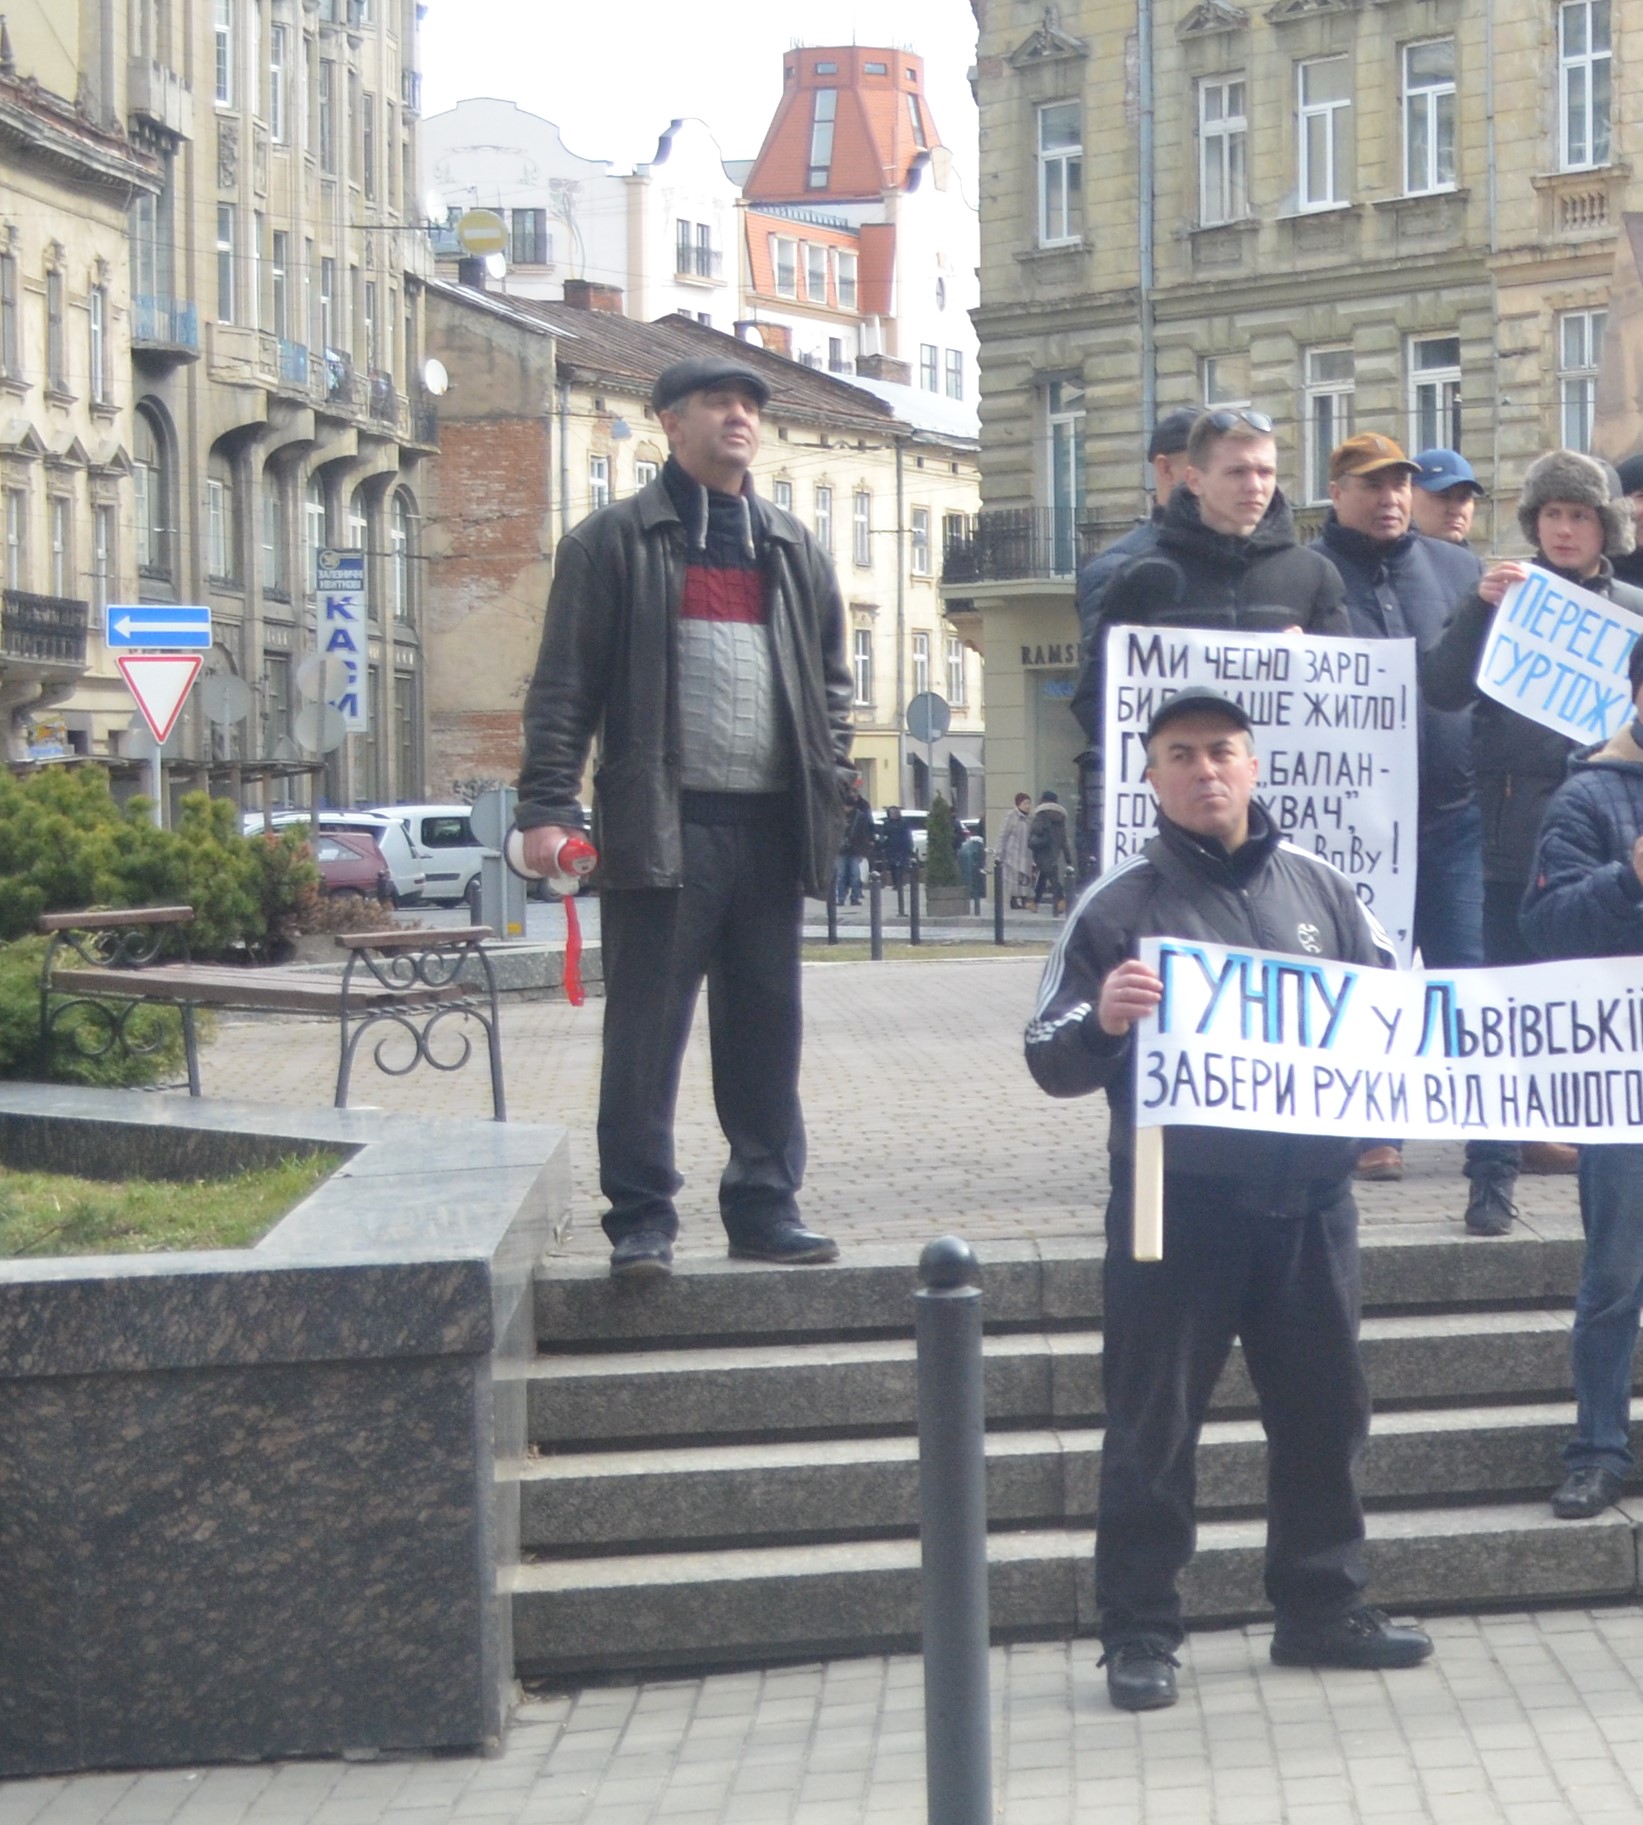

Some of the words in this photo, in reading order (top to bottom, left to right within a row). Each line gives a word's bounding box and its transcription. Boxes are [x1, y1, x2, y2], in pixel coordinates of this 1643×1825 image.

[1021, 644, 1080, 665] RAMS
[1204, 646, 1290, 682] ЧЕСНО
[1303, 685, 1407, 730] ЖИТЛО!
[1158, 943, 1360, 1050] ГУНПУ
[1370, 1005, 1403, 1055] У
[1143, 1050, 1296, 1117] ЗАБЕРИ
[1313, 1065, 1410, 1123] РУКИ
